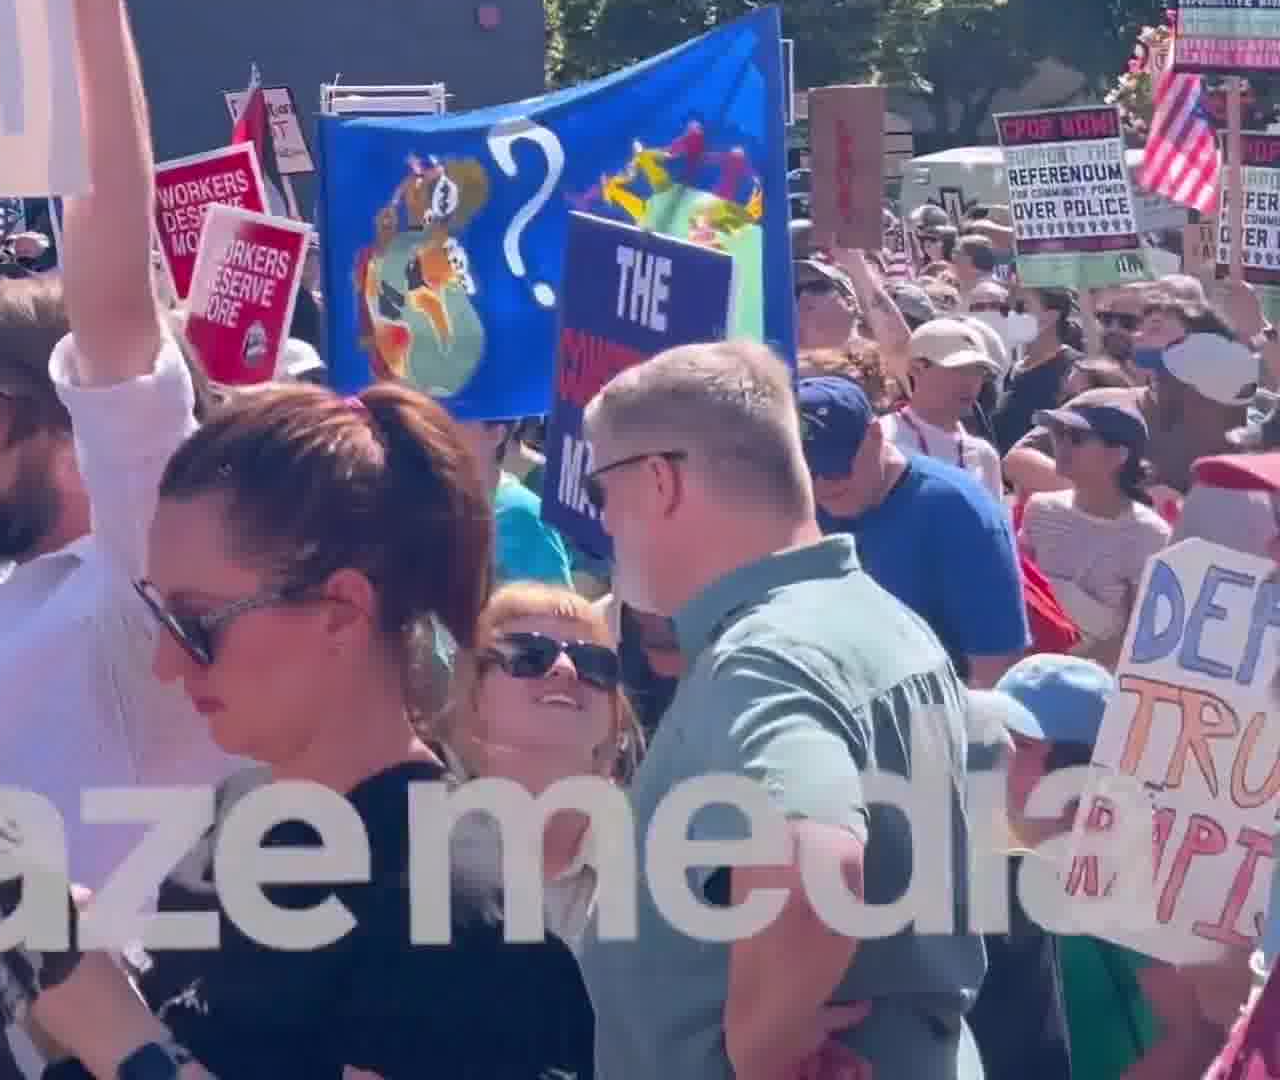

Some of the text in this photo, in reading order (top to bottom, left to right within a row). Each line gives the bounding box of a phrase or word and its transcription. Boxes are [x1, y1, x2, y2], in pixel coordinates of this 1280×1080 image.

[158, 168, 250, 210] WORKERS
[1008, 162, 1123, 186] REFERENDUM
[1013, 197, 1131, 220] OVER POLICE
[171, 231, 201, 258] MO
[224, 239, 291, 281] ORKERS
[209, 265, 278, 308] ESERVE
[616, 244, 674, 333] THE
[206, 296, 244, 329] ORE
[1120, 673, 1280, 809] TRU
